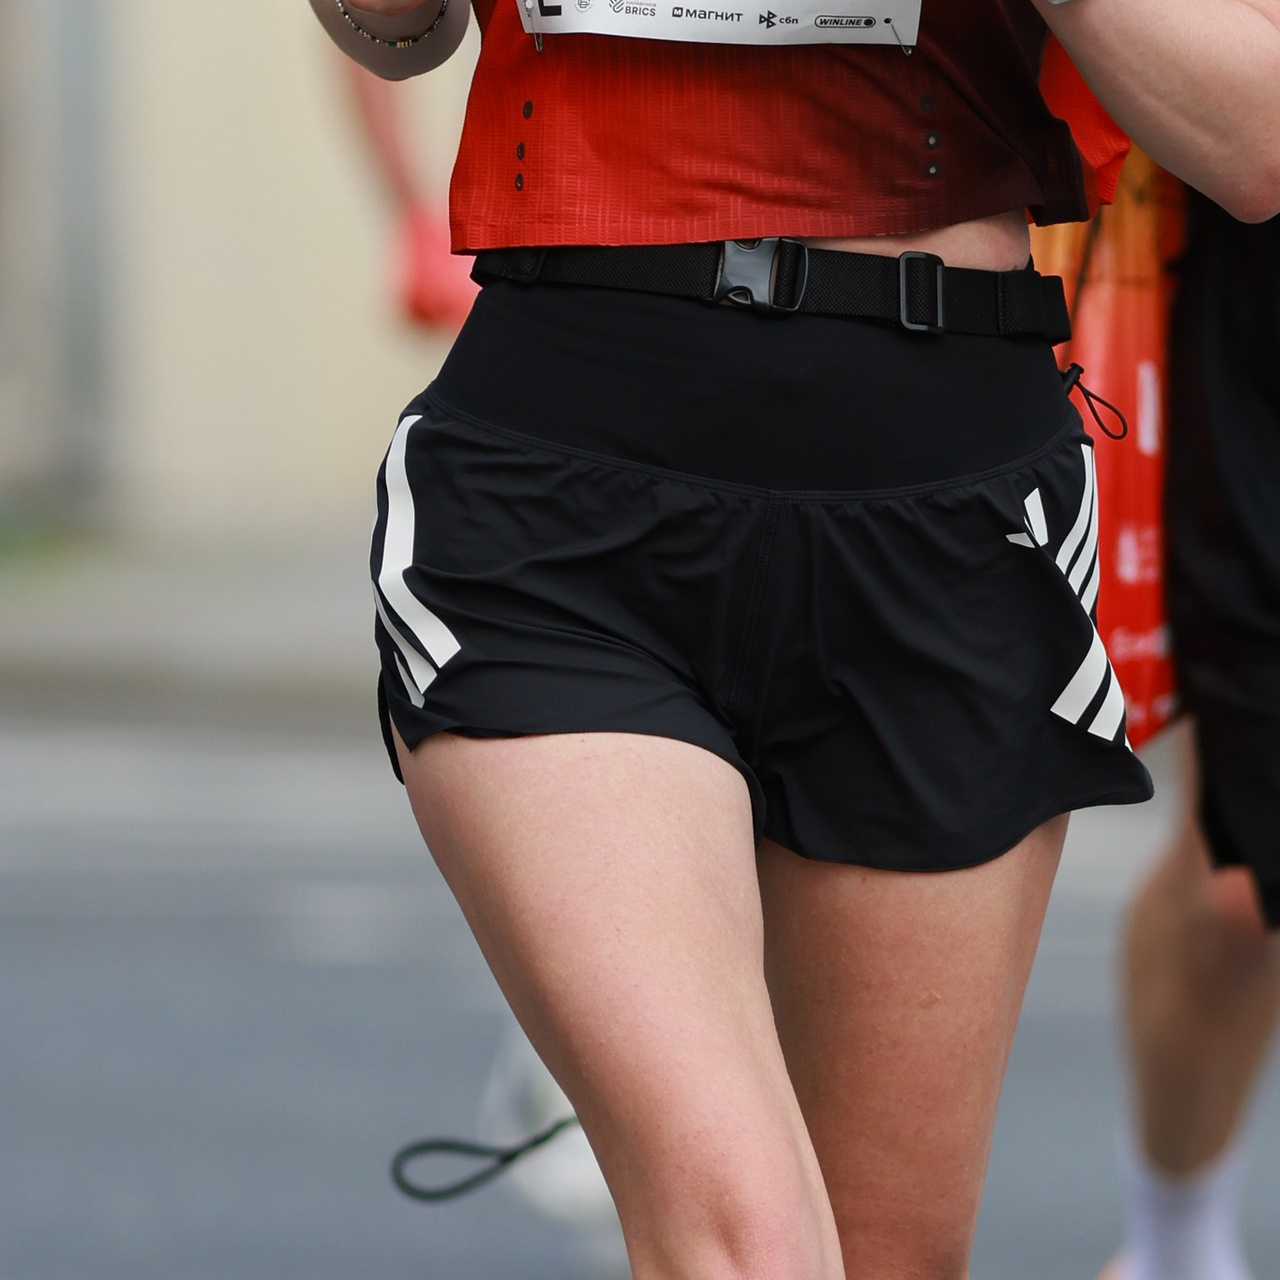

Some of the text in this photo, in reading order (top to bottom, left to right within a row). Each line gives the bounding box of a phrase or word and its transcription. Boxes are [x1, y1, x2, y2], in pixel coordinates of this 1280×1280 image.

[625, 6, 656, 17] BRICS
[779, 16, 799, 25] сбп
[819, 18, 863, 27] WINLINE
